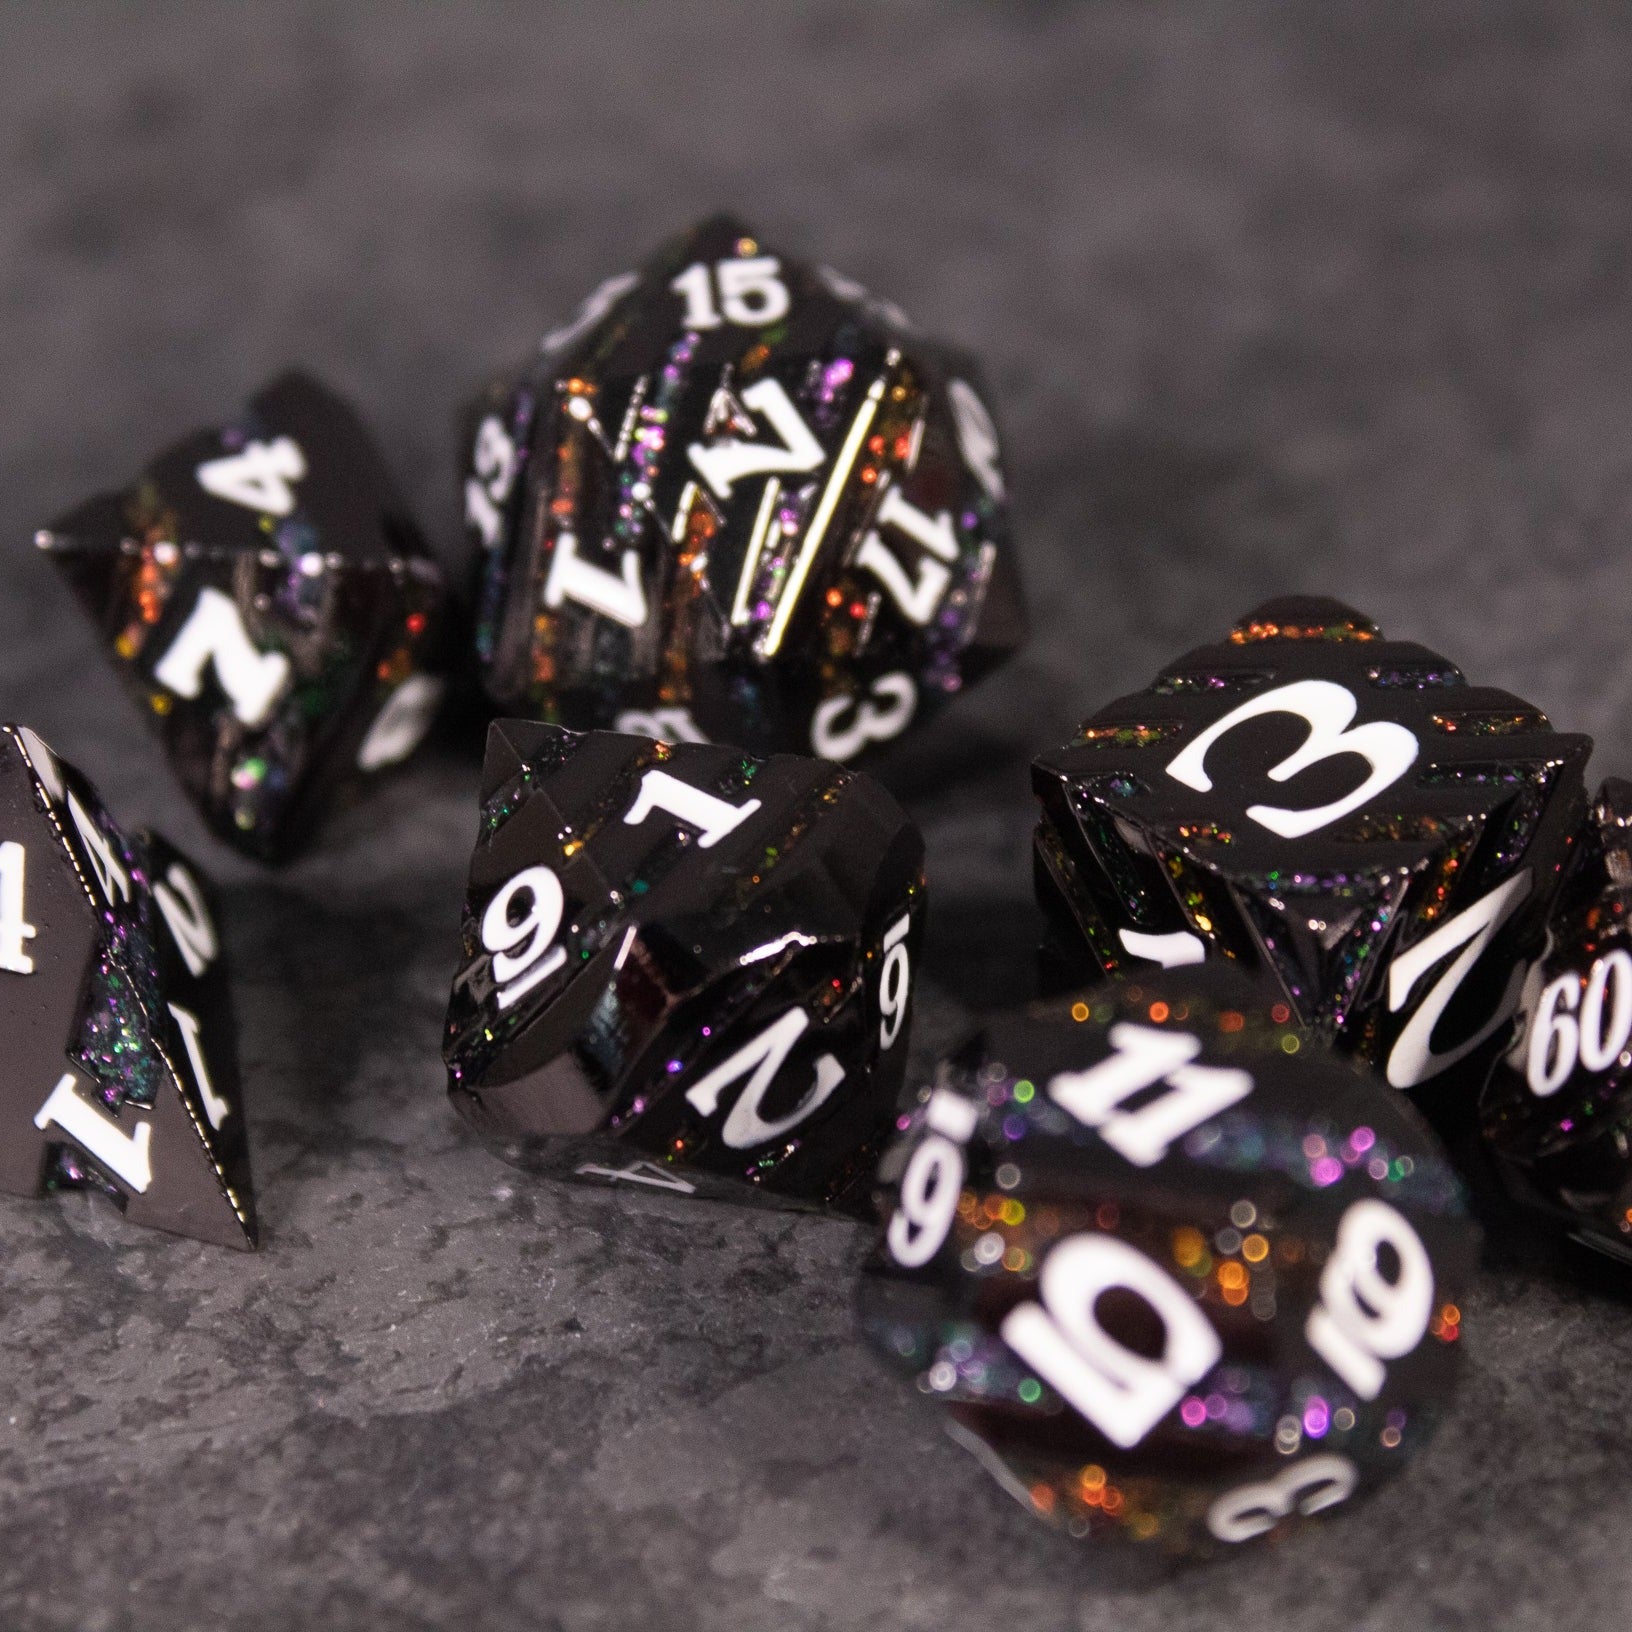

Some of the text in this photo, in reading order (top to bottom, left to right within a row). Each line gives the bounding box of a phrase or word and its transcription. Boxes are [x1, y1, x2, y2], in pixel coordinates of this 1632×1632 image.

[673, 257, 790, 328] 15
[197, 437, 306, 516] 4
[688, 378, 826, 498] 7
[543, 531, 648, 630] 1
[856, 485, 960, 623] 17
[810, 671, 917, 762] 3
[1164, 679, 1420, 839] 3
[66, 789, 130, 908] 4
[623, 769, 762, 849] 1
[167, 1002, 229, 1132] 1
[685, 1006, 846, 1149] 2
[1526, 949, 1632, 1097] 60
[33, 1072, 154, 1195] 1
[1048, 1022, 1253, 1167] 11
